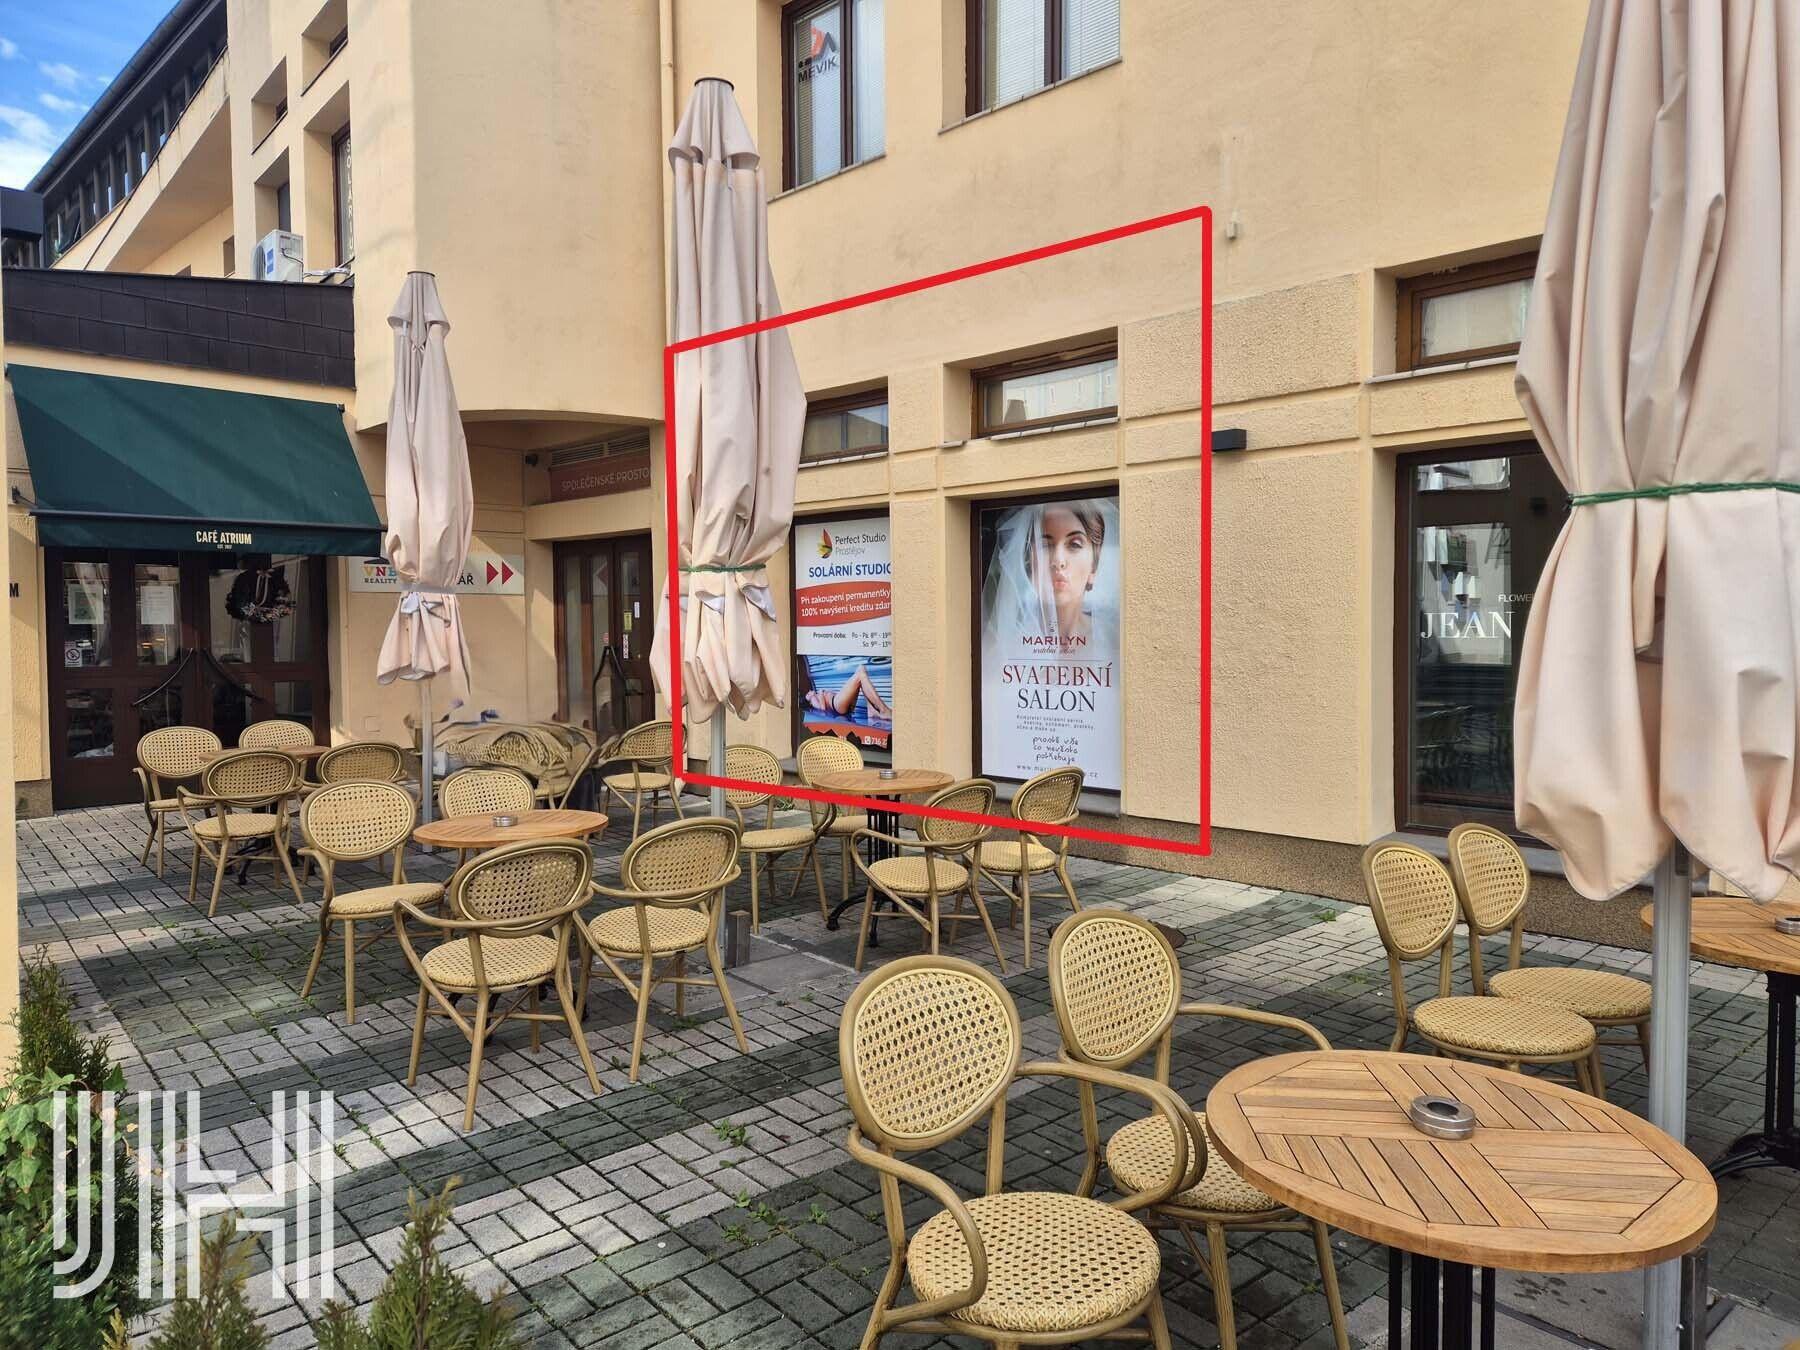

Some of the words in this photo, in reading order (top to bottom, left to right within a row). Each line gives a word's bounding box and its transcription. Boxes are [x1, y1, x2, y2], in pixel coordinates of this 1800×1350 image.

[798, 56, 837, 82] MEVIK
[196, 529, 218, 543] CAFÉ
[220, 532, 252, 545] ATRIUM
[835, 536, 860, 545] Perfect
[862, 532, 887, 543] Studio
[808, 561, 853, 578] SOLÁRNÍ
[811, 592, 845, 604] zakoupení
[845, 587, 891, 602] permanentky
[801, 607, 818, 617] 100%
[819, 604, 849, 616] navýšení
[849, 602, 874, 612] kreditu
[1421, 611, 1516, 639] JEAN
[1022, 635, 1086, 646] MARILYN
[1002, 661, 1113, 688] SVATEBNÍ
[1017, 688, 1097, 713] SALON
